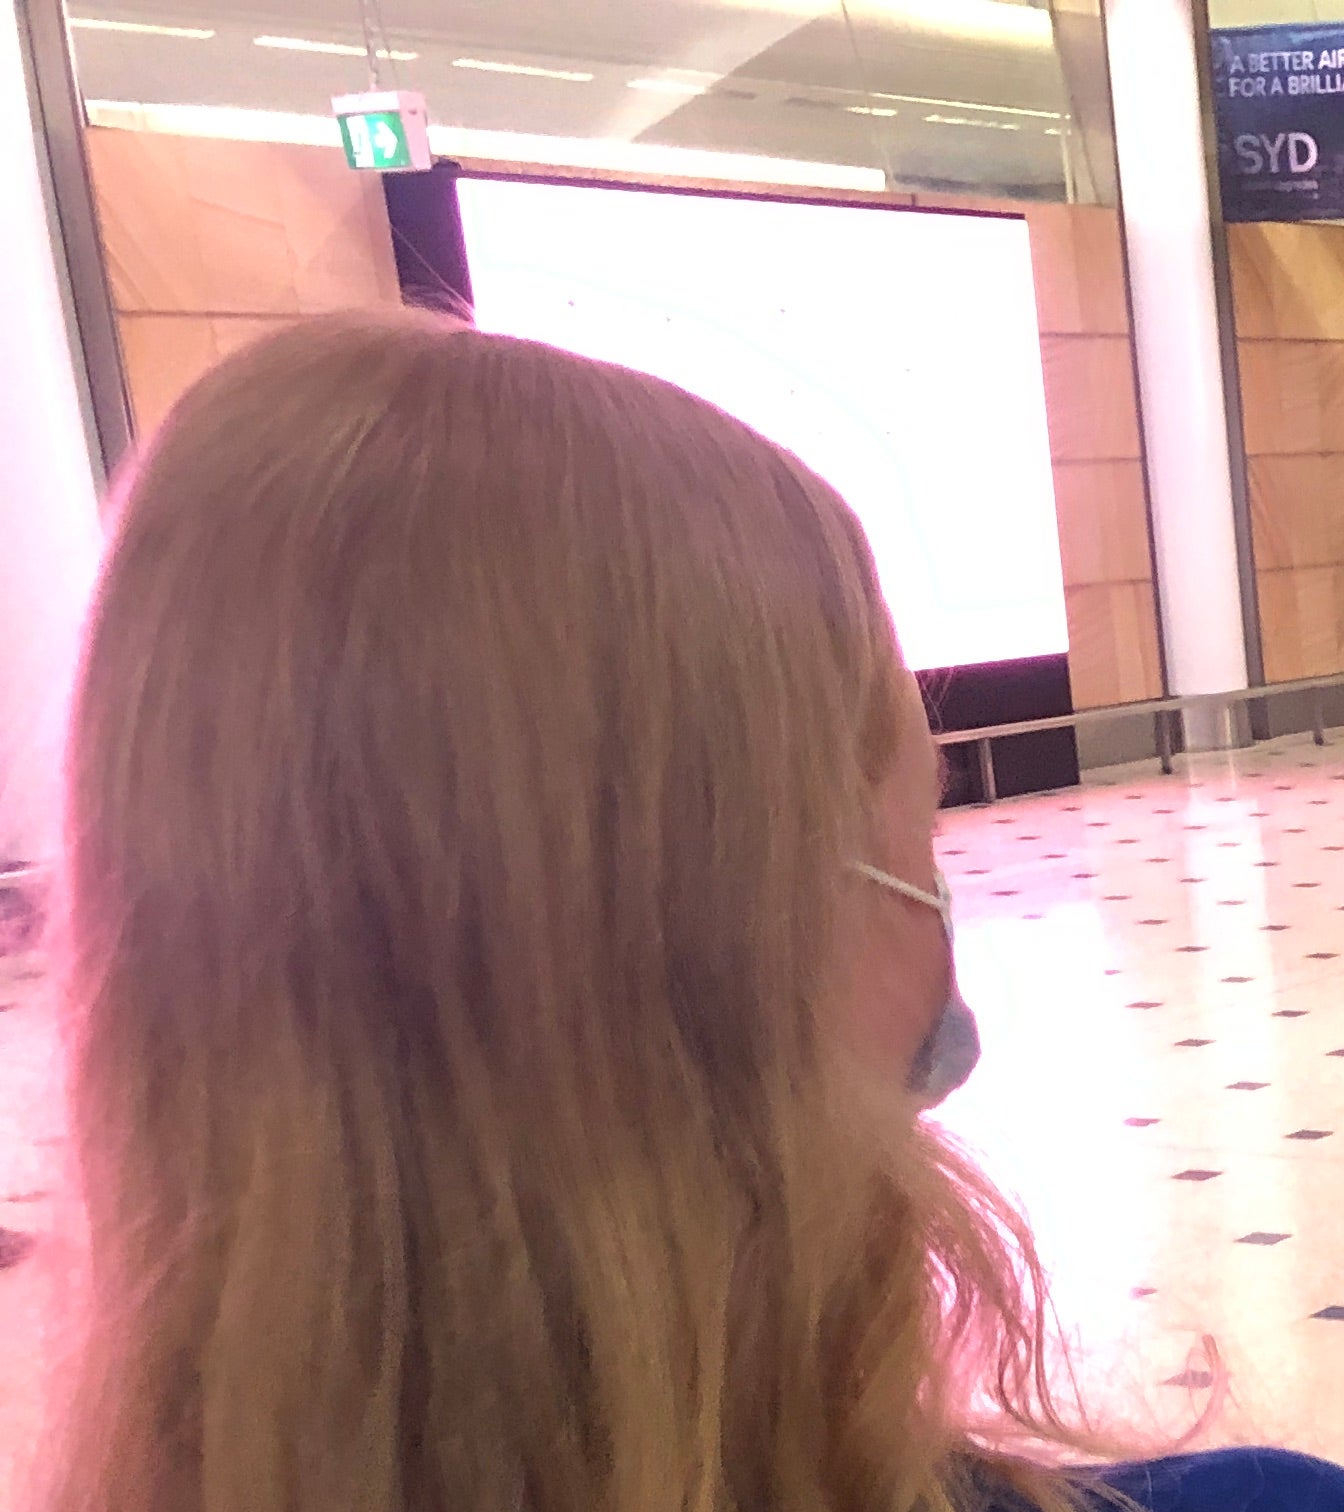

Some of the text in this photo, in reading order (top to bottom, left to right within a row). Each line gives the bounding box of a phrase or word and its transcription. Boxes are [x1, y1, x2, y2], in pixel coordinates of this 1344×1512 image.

[1230, 55, 1246, 74] A
[1247, 51, 1315, 74] BETTER
[1228, 76, 1266, 98] FOR
[1270, 76, 1285, 95] A
[1233, 131, 1319, 174] SYD
